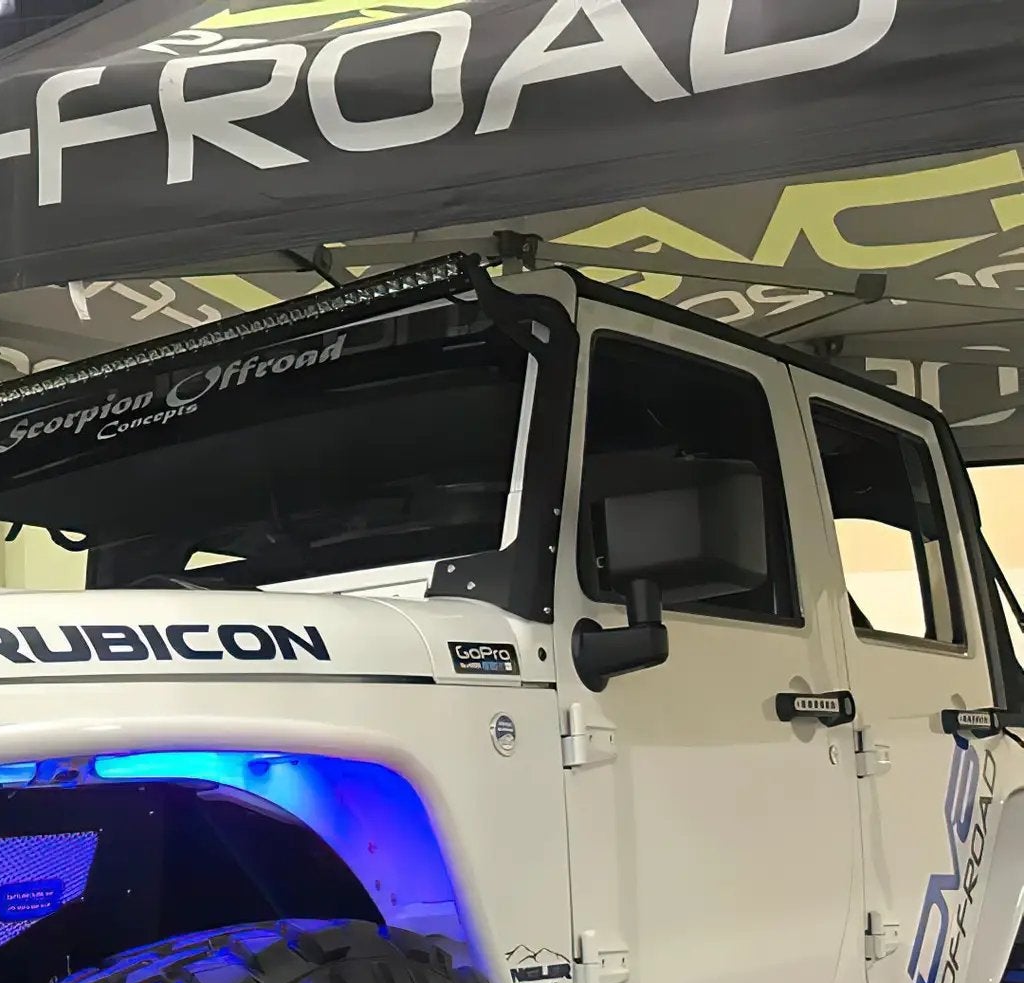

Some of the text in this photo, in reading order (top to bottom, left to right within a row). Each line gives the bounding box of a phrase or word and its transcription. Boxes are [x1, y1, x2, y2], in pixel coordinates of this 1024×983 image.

[165, 332, 348, 408] Offroad
[96, 402, 199, 440] Concepts
[455, 645, 511, 661] GoPro
